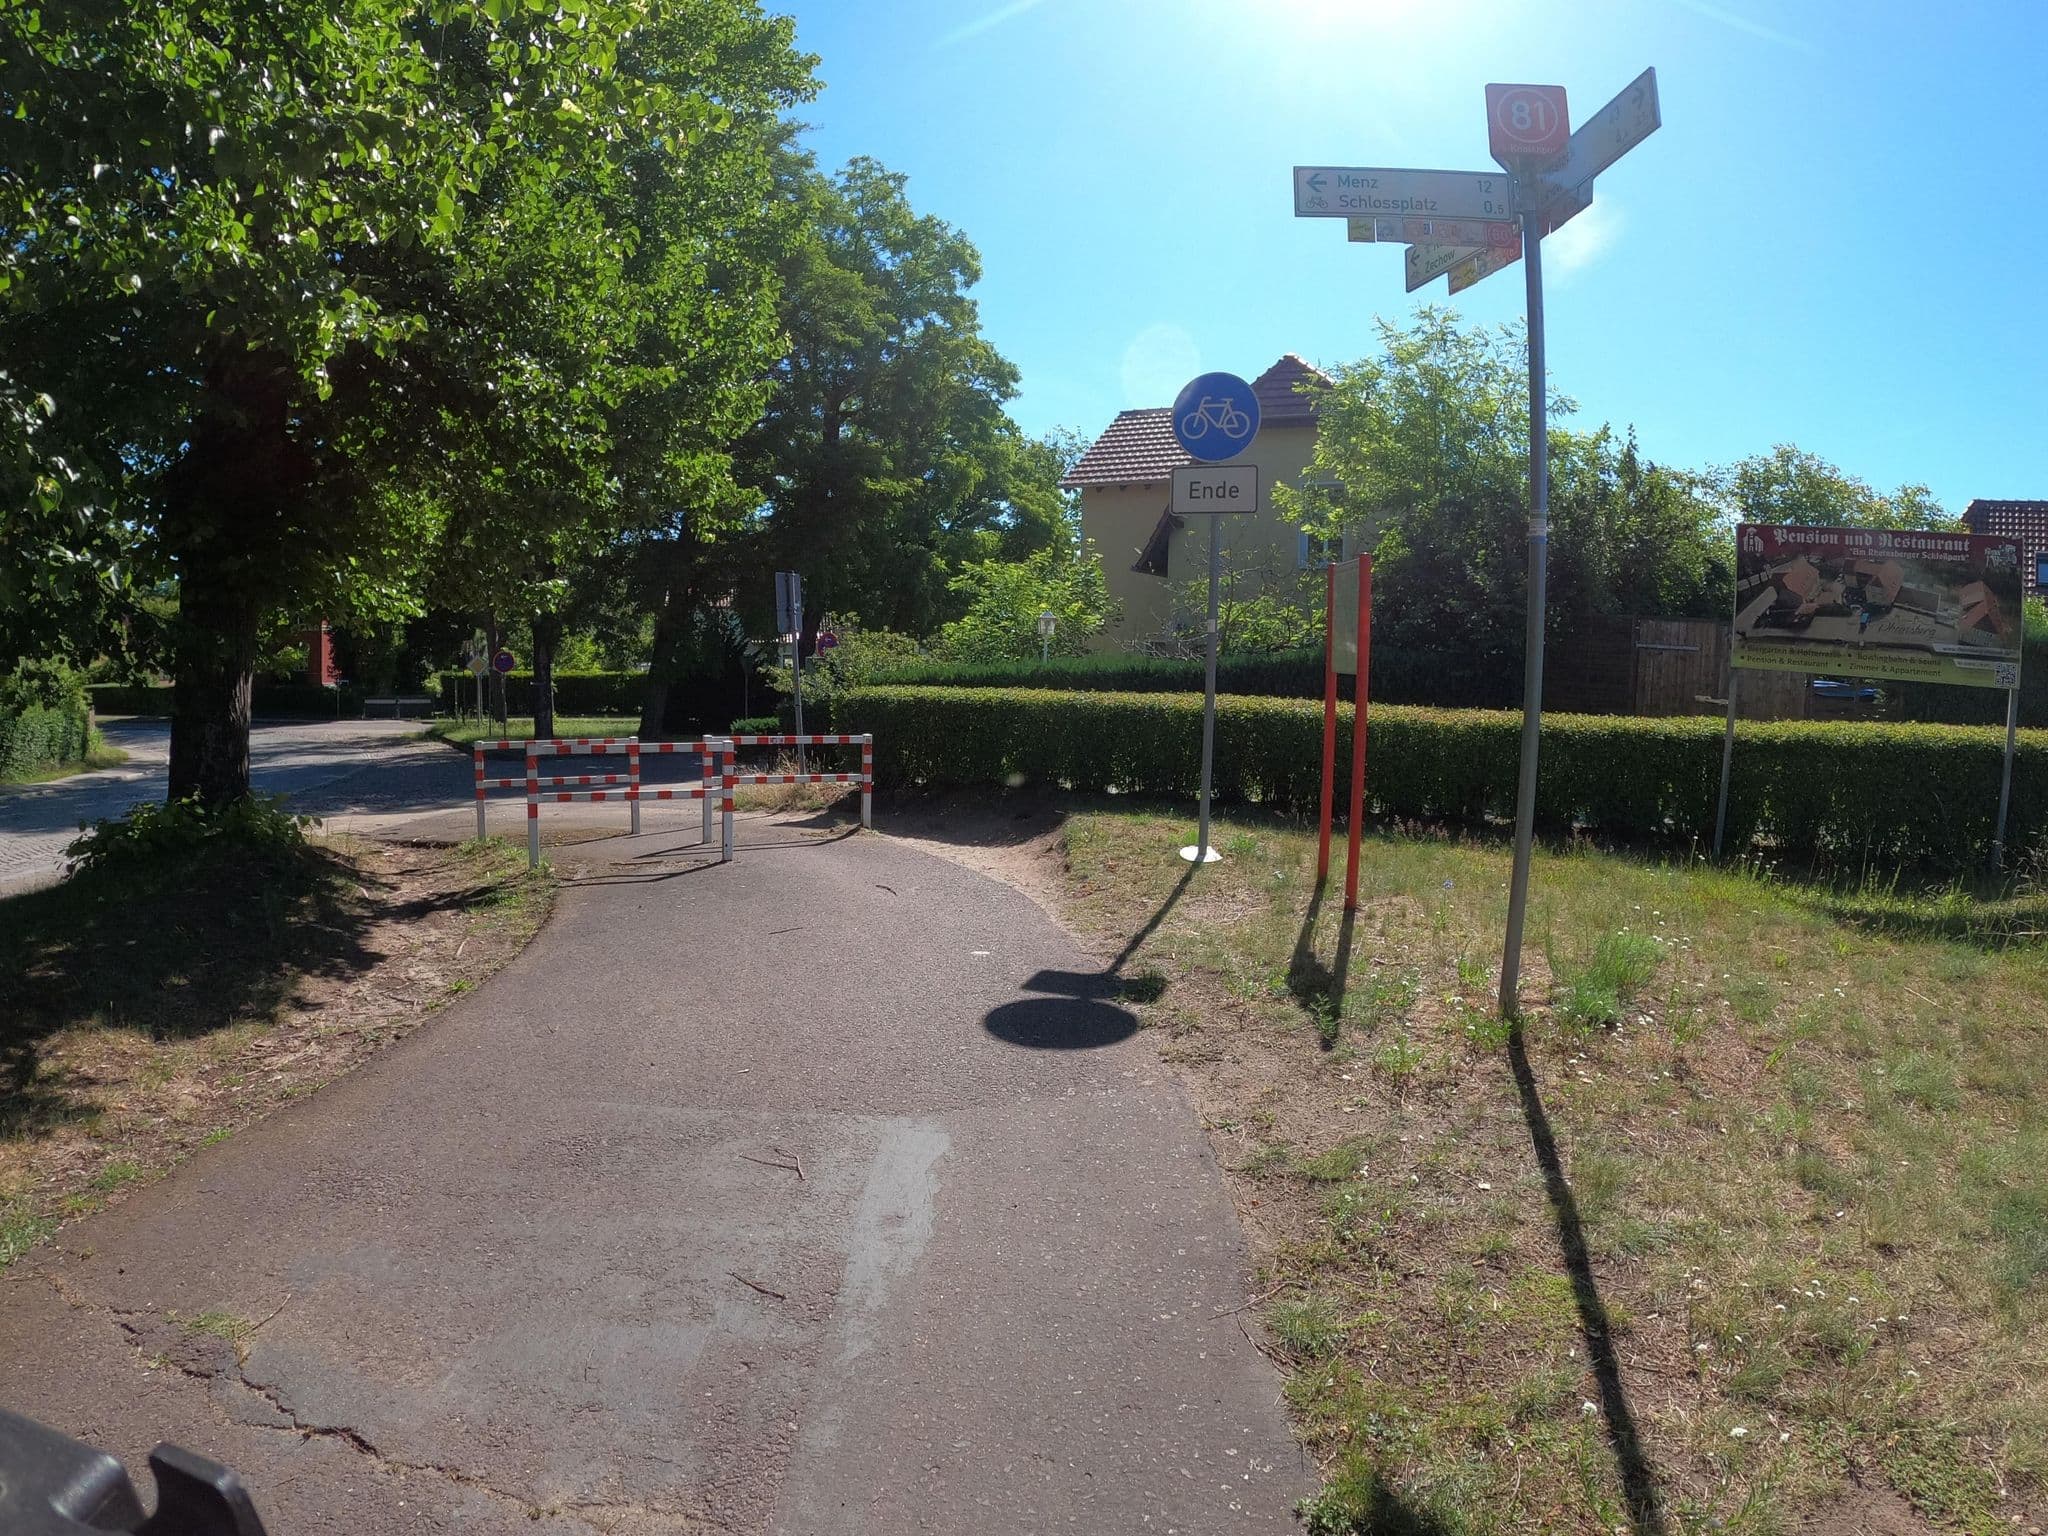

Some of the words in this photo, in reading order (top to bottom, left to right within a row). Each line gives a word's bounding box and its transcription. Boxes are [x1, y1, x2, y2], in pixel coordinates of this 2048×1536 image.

[1511, 101, 1546, 130] 81
[1336, 175, 1379, 189] Menz
[1476, 179, 1493, 194] 12
[1338, 195, 1438, 213] Schlossplatz
[1189, 481, 1240, 499] Ende
[1773, 528, 1839, 545] Pension
[1844, 530, 1873, 546] und
[1878, 533, 1970, 552] Restaurant
[1919, 657, 1941, 666] Saun
